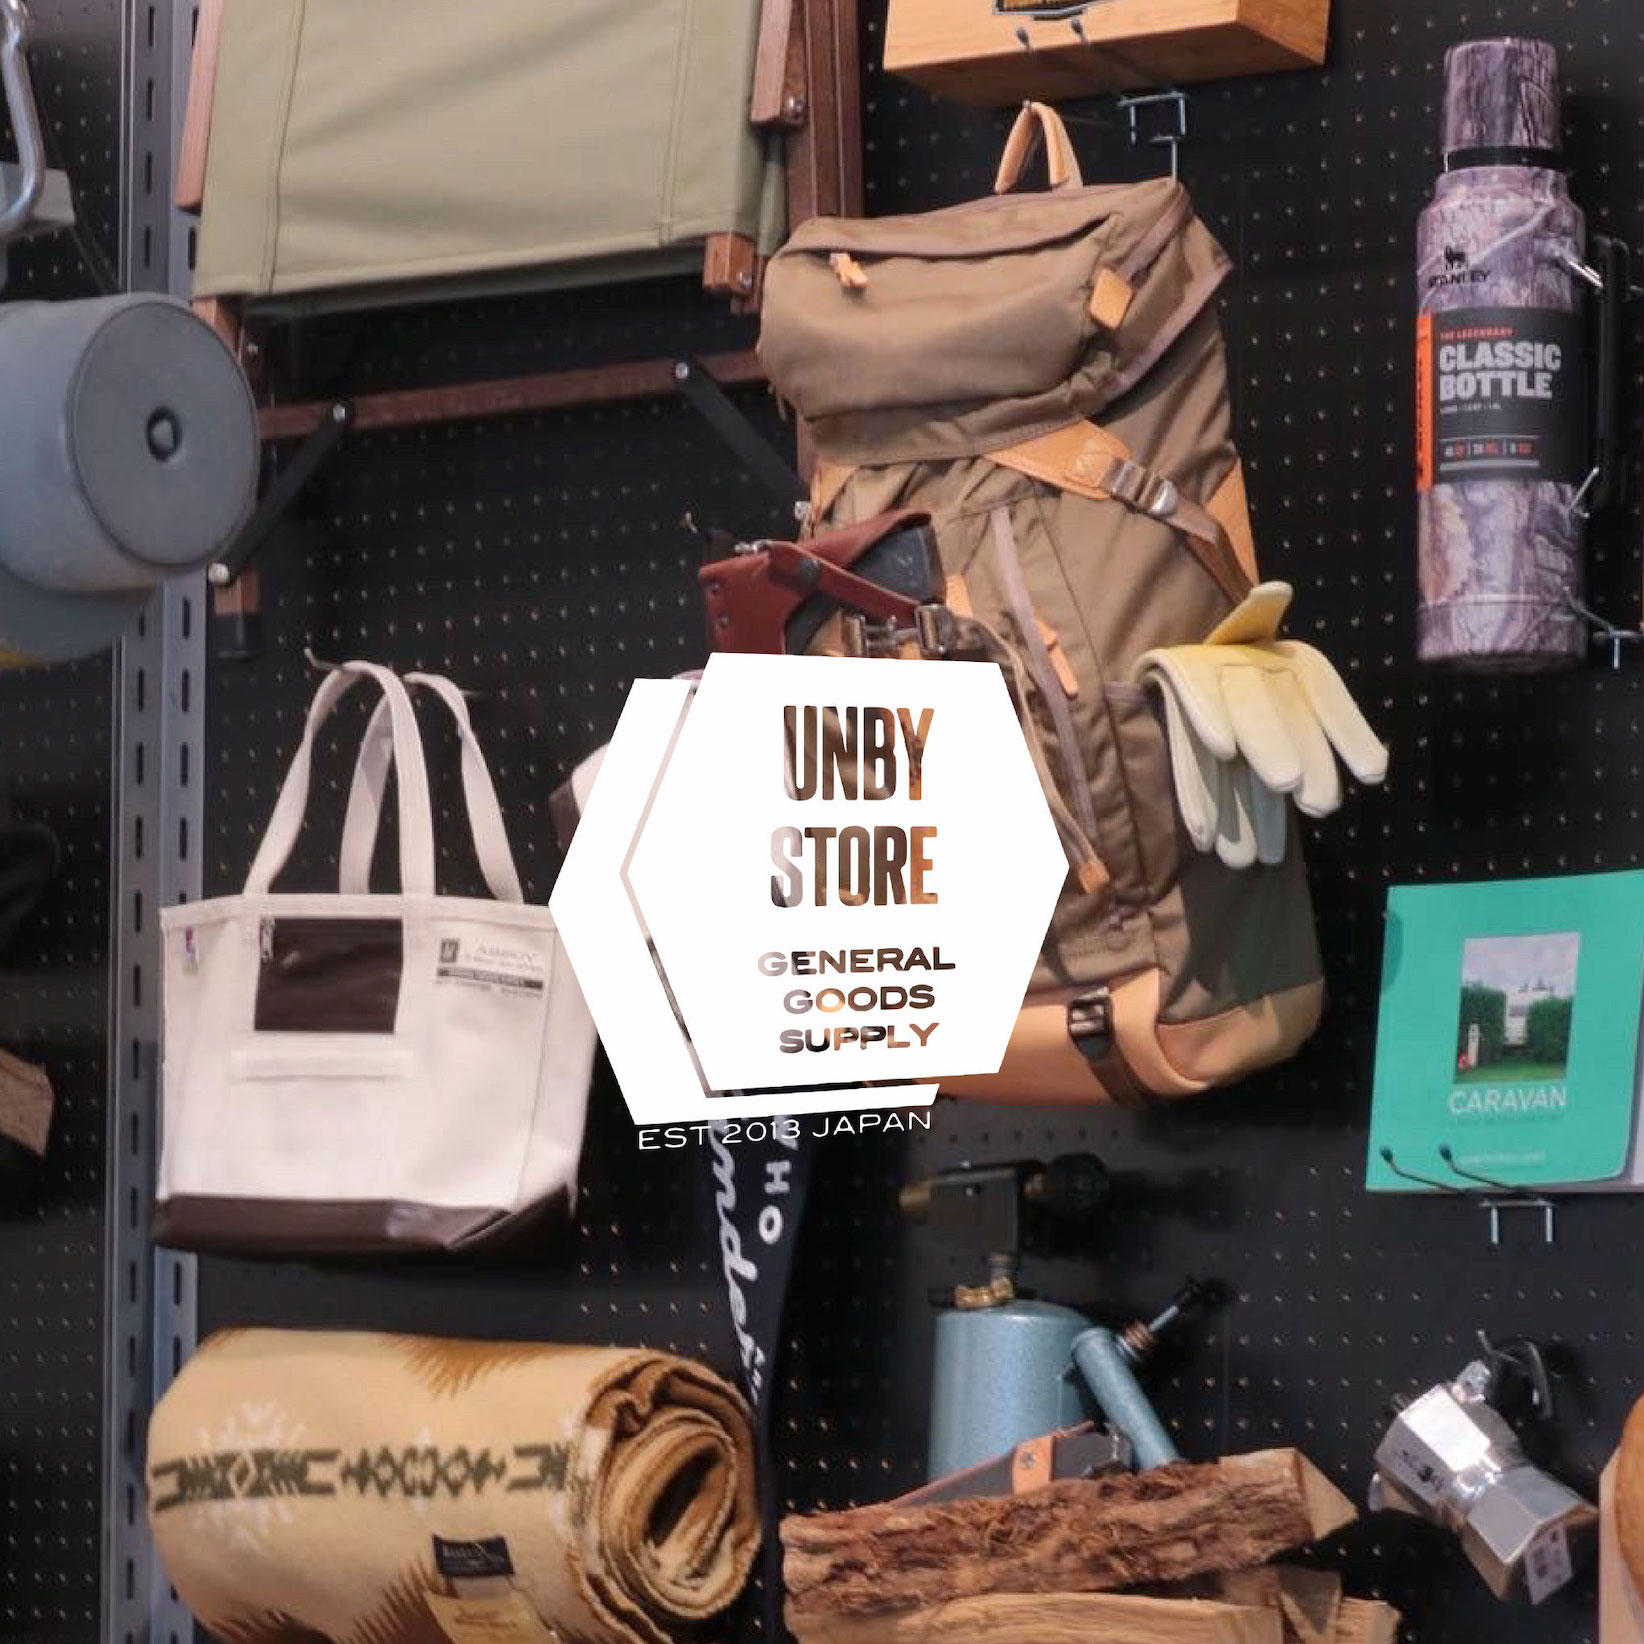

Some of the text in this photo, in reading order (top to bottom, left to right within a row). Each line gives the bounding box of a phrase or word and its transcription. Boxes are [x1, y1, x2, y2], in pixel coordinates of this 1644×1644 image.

[1439, 341, 1562, 371] CLASSIC
[1439, 370, 1553, 401] BOTTLE
[1449, 1086, 1567, 1115] CARAVAN
